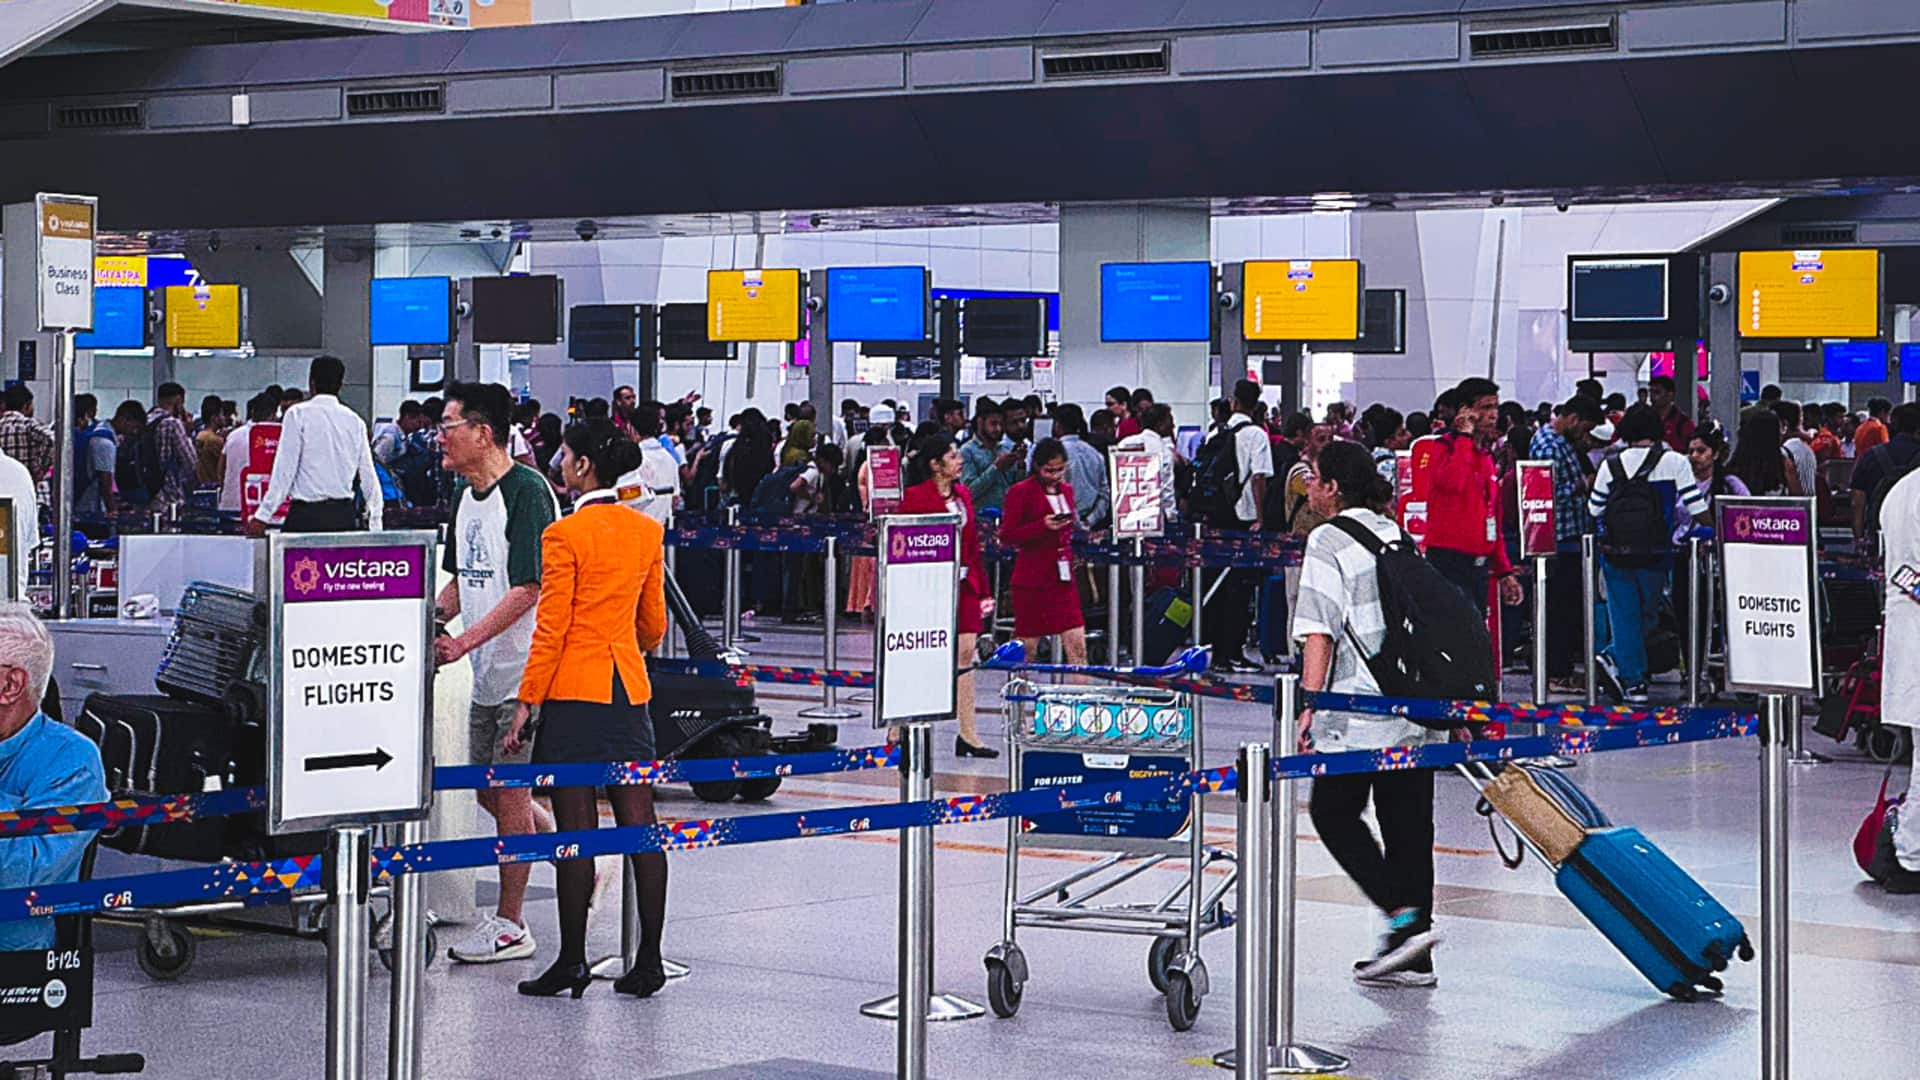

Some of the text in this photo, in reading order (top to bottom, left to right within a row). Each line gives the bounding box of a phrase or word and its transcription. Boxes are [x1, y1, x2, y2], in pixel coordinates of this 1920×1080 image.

[48, 265, 88, 280] Business
[55, 281, 80, 295] Class
[1738, 595, 1801, 613] DOMESTIC
[1745, 620, 1796, 638] FLIGHTS
[886, 629, 948, 652] CASHIER
[292, 643, 405, 669] DOMESTIC
[304, 681, 394, 707] FLIGHTS
[1034, 775, 1084, 787] FOR FASTER
